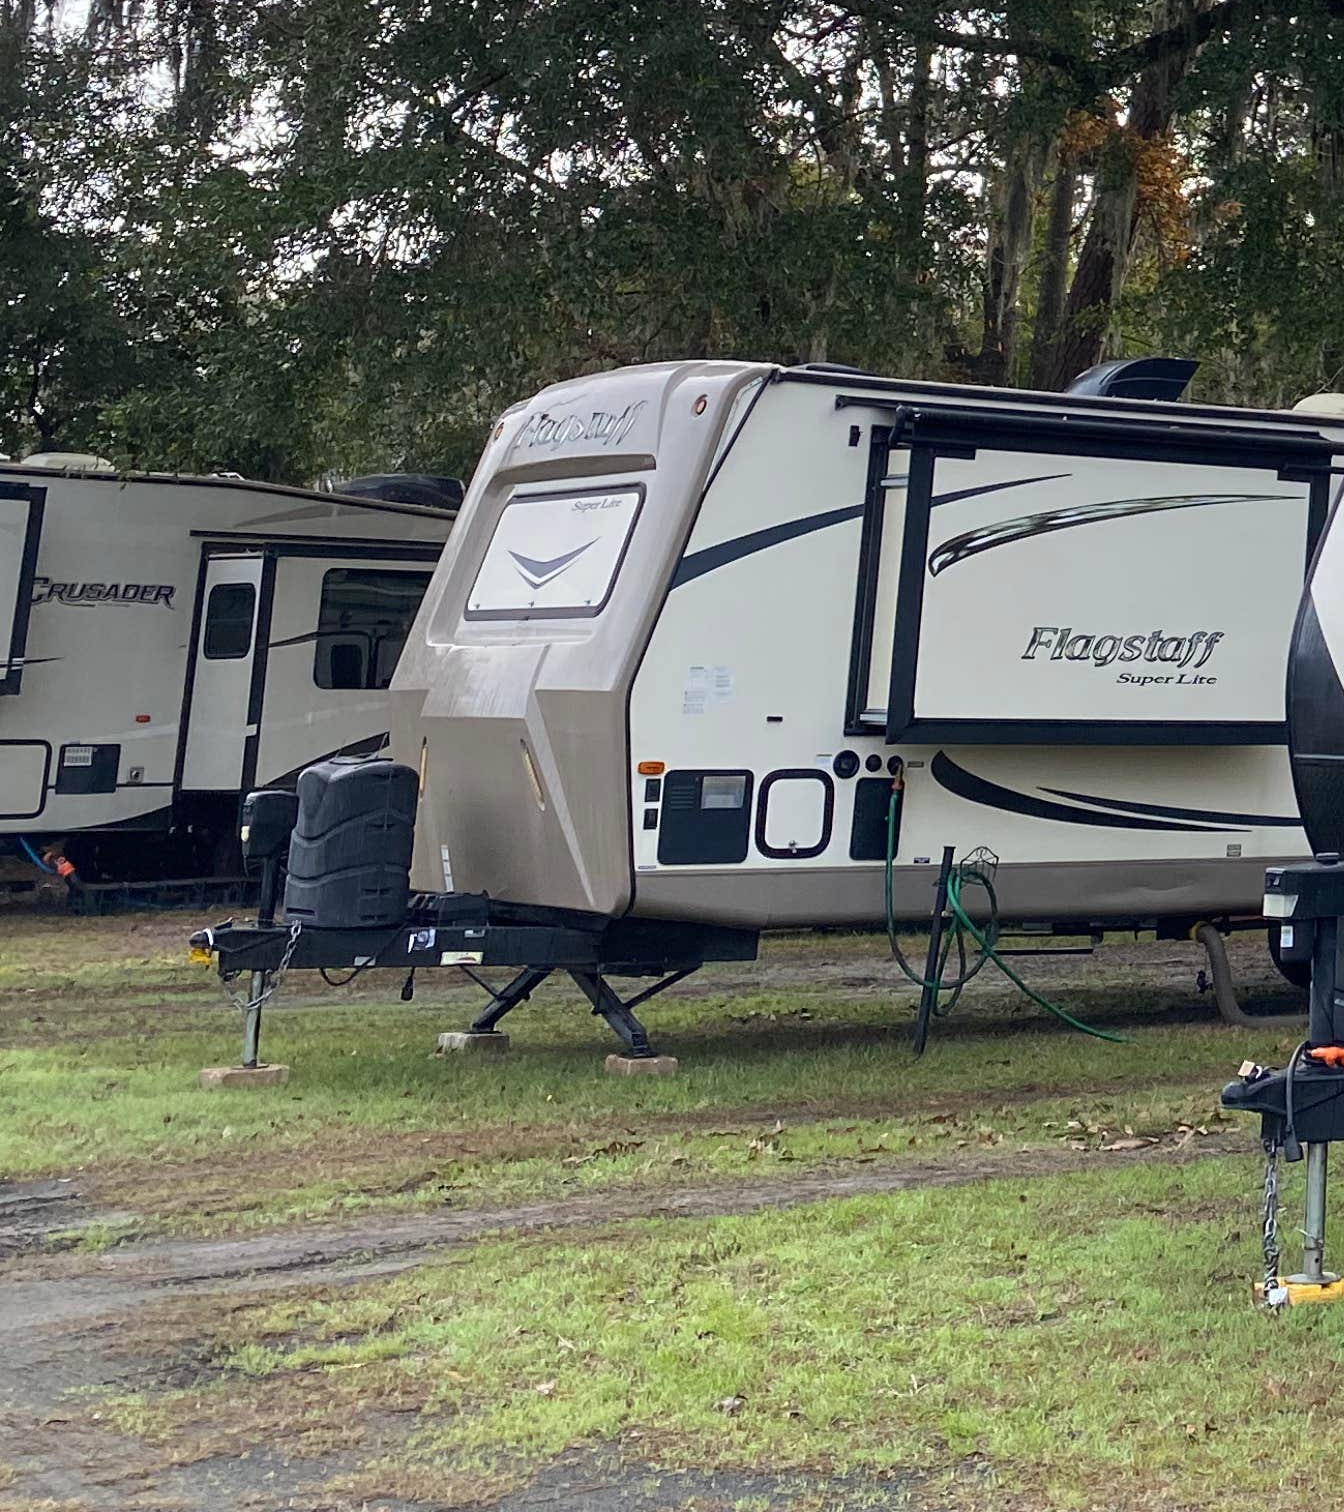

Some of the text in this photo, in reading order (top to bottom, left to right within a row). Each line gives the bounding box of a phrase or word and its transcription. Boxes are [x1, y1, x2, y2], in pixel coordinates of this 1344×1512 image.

[31, 577, 176, 610] CRUSADER
[1021, 627, 1224, 668] Flagstaff
[1116, 673, 1217, 686] Super Lite
